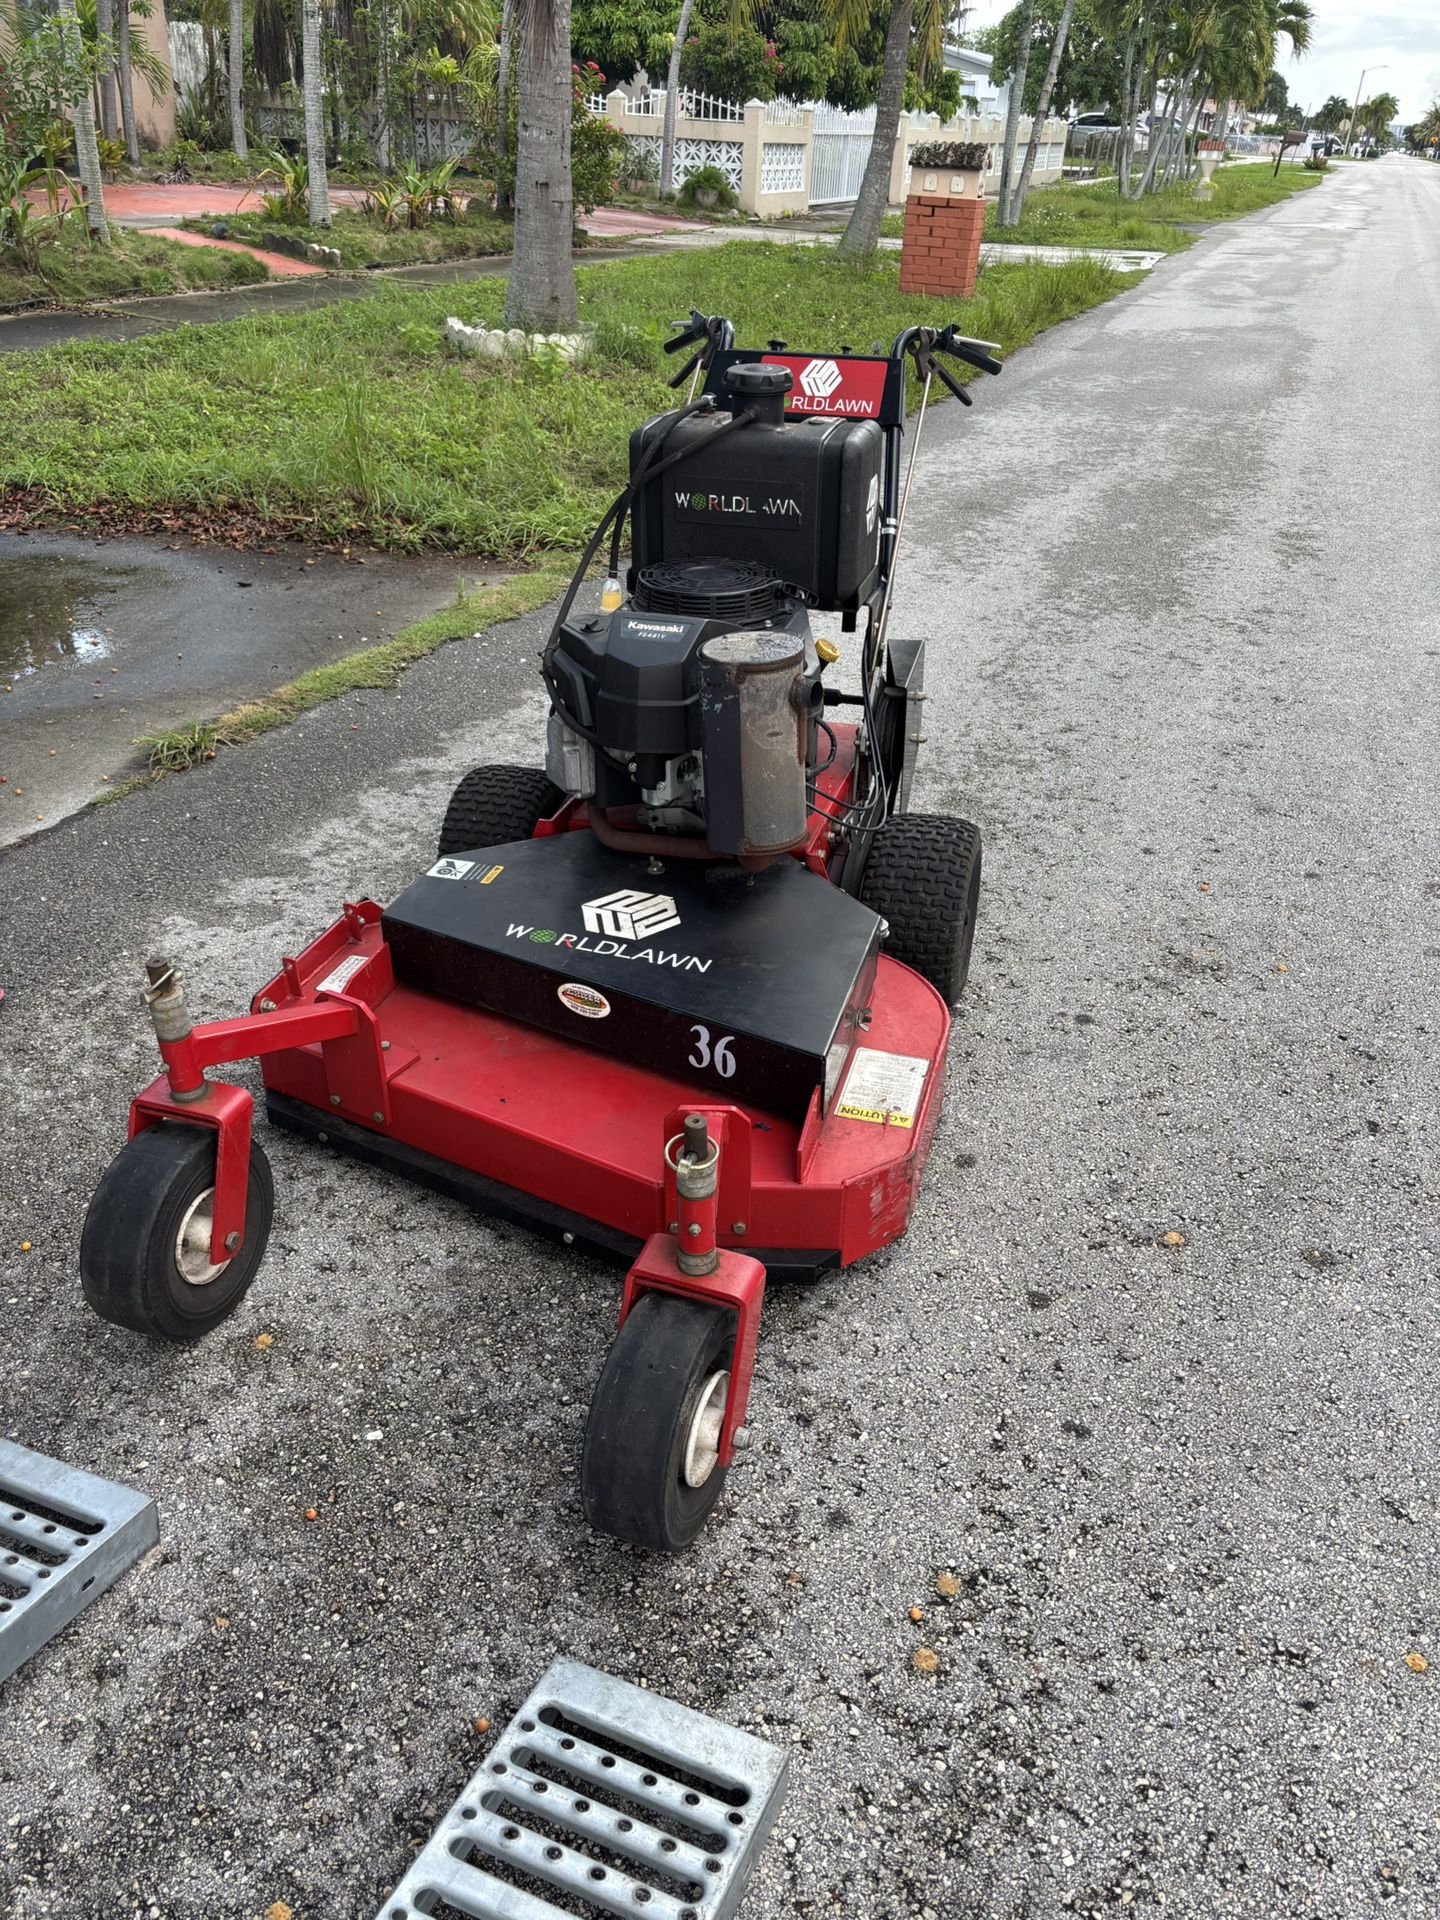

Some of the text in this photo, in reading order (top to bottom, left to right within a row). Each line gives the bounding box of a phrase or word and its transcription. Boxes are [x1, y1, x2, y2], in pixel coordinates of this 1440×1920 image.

[627, 620, 685, 633] Kawasaki
[505, 922, 713, 973] WORLDLAWN
[688, 1024, 737, 1078] 36
